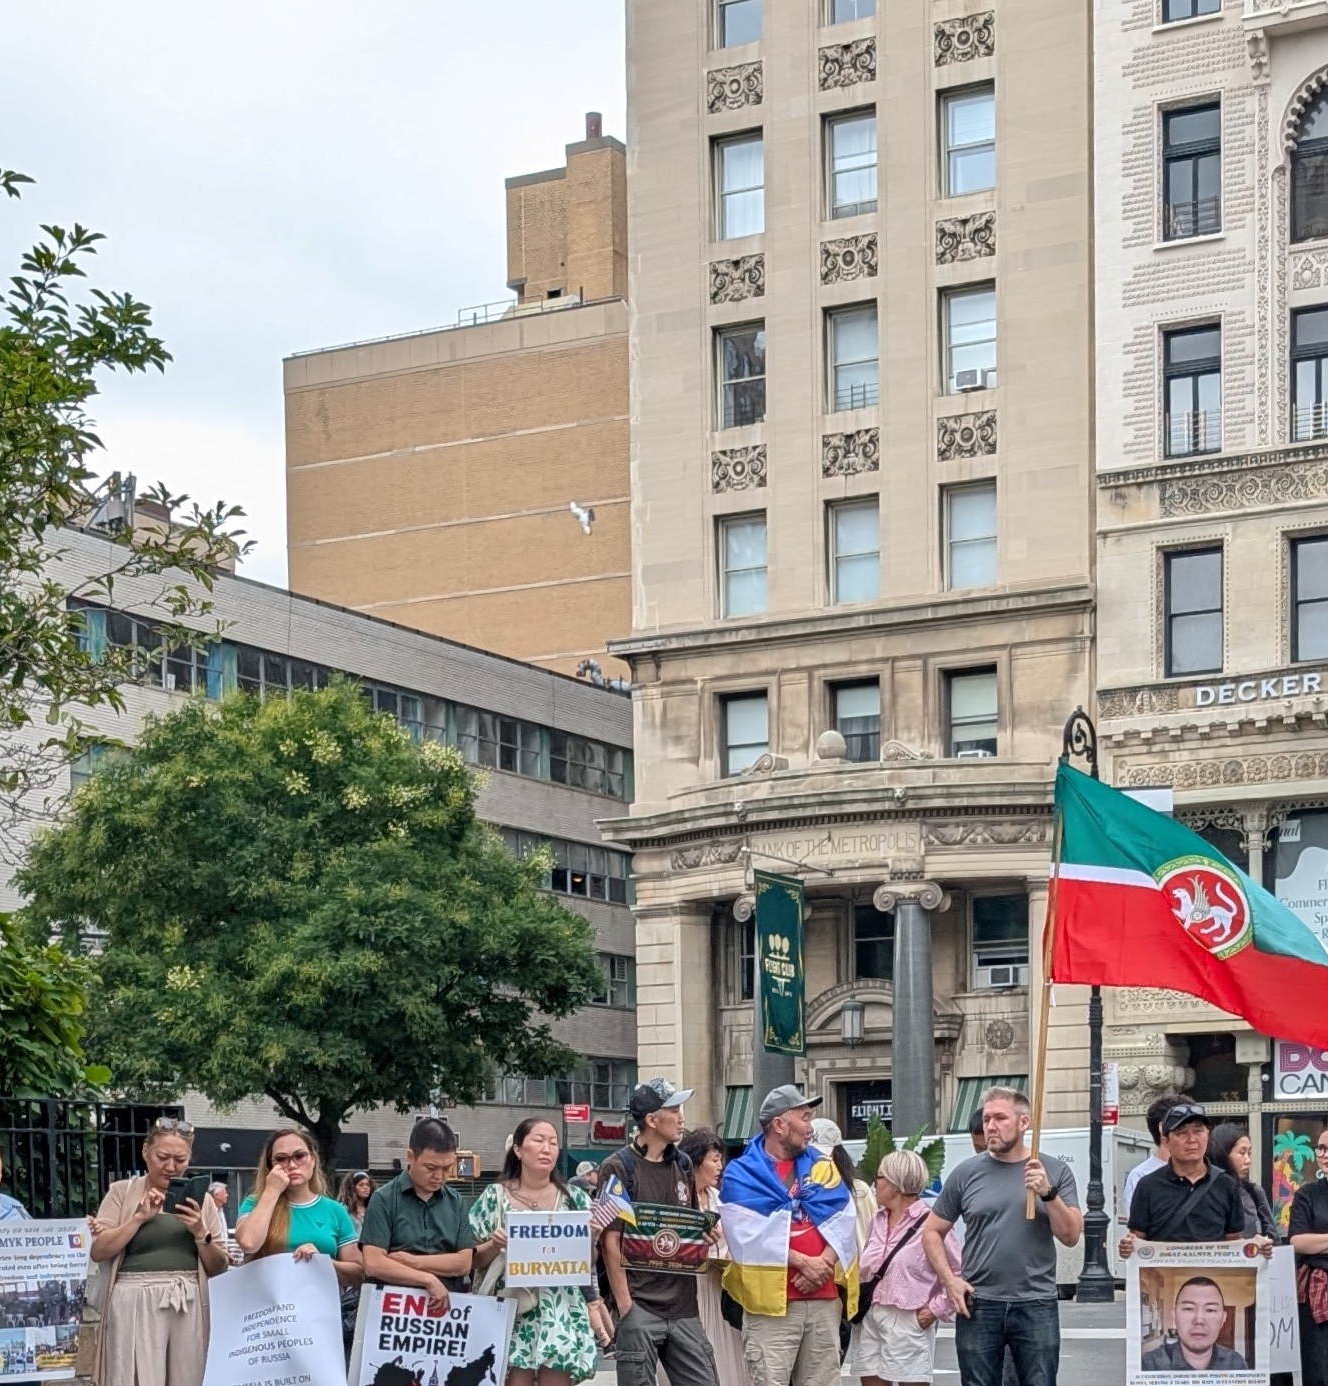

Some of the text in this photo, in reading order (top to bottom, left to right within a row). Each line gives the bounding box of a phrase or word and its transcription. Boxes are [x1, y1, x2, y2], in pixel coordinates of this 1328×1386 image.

[1195, 672, 1322, 707] DECKER
[786, 840, 801, 858] OF
[804, 839, 828, 856] THE
[830, 832, 917, 855] METROPOLIS
[509, 1224, 589, 1239] FREEDOM
[25, 1236, 64, 1247] PEOPLE
[508, 1260, 590, 1276] BURYATIA
[276, 1303, 295, 1312] AND
[450, 1305, 473, 1321] of
[241, 1315, 298, 1334] INDEPENDENCE
[380, 1315, 469, 1339] RUSSIAN
[246, 1328, 290, 1343] FOR SMALL
[228, 1337, 314, 1358] INDIGENOUS PEOPLES
[378, 1333, 467, 1358] EMPIRE!
[248, 1352, 291, 1366] OF RUSSIA
[274, 1376, 298, 1386] BUILT
[298, 1374, 311, 1384] ON
